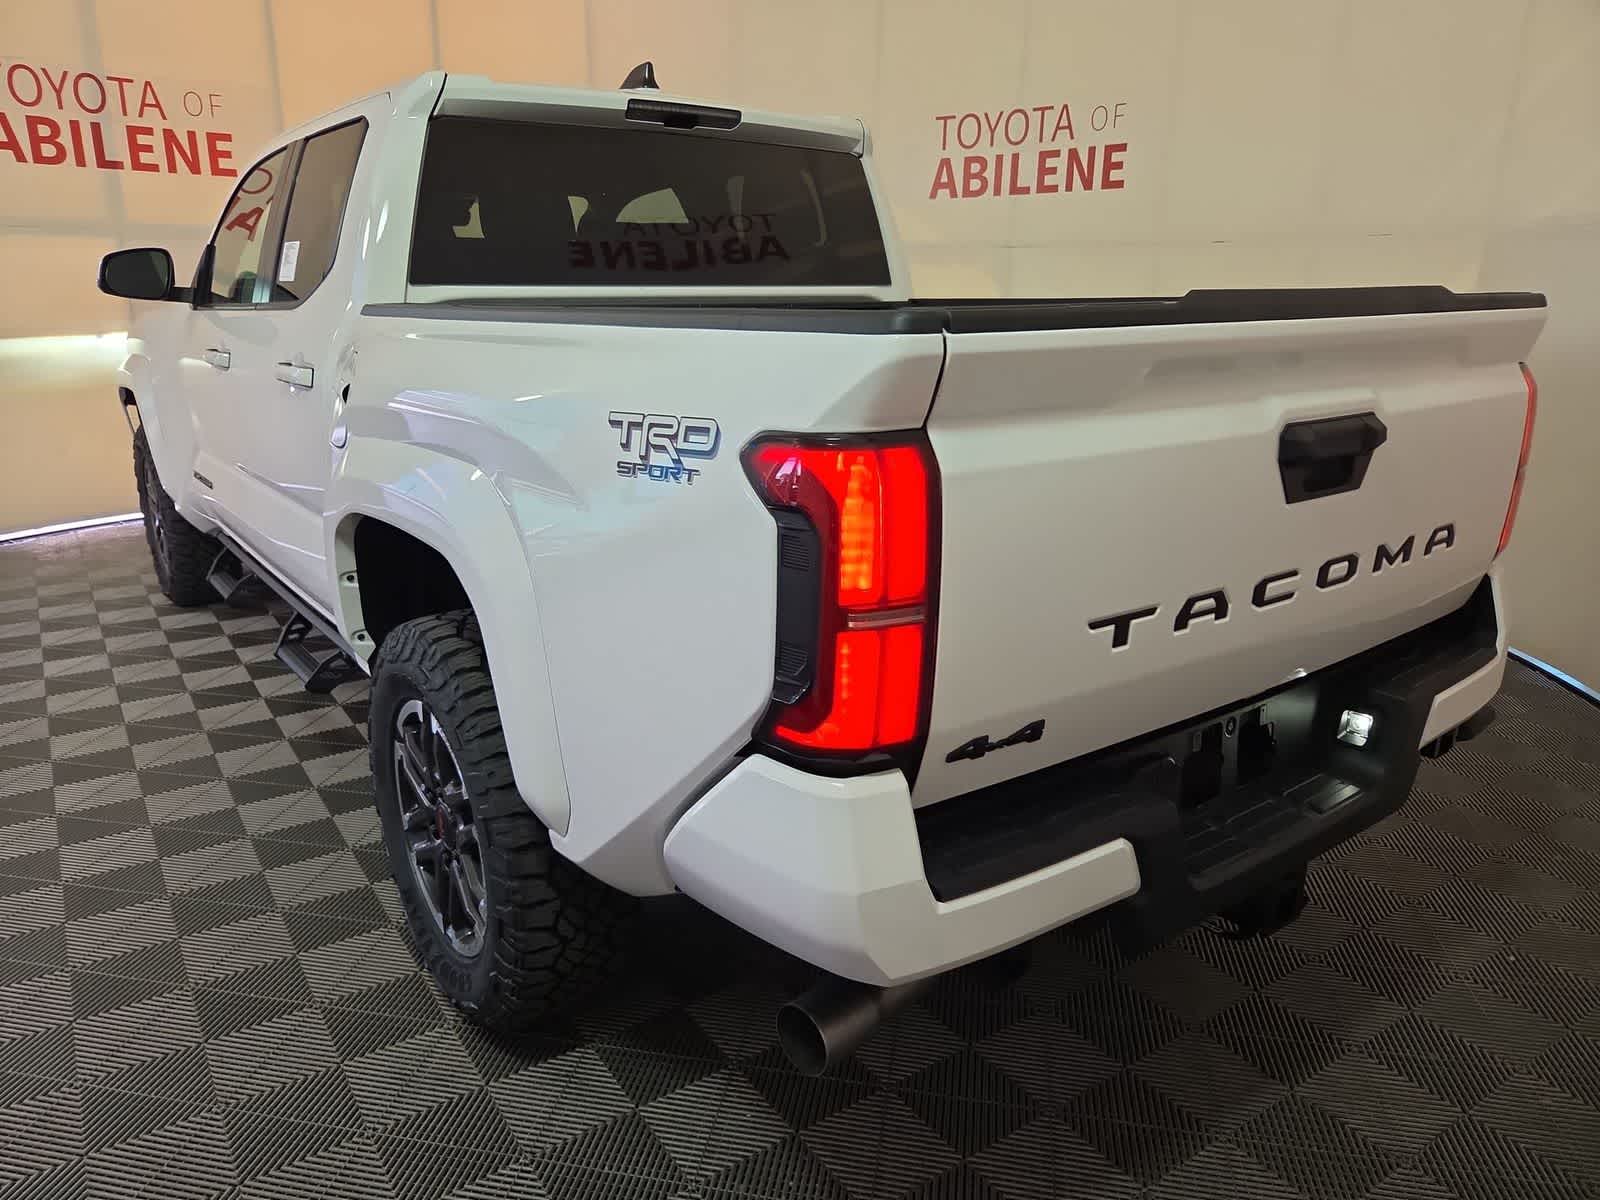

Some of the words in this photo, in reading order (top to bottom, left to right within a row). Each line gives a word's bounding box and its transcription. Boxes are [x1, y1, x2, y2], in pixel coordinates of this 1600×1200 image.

[0, 61, 167, 120] OYOTA
[183, 90, 223, 118] OF
[0, 112, 238, 177] ABILENE
[936, 104, 1074, 150] TOYOTA
[1091, 103, 1127, 131] OF
[929, 143, 1128, 199] ABILENE
[608, 411, 721, 467] TRD
[617, 461, 700, 485] SPORT
[1088, 523, 1455, 649] TACOMA
